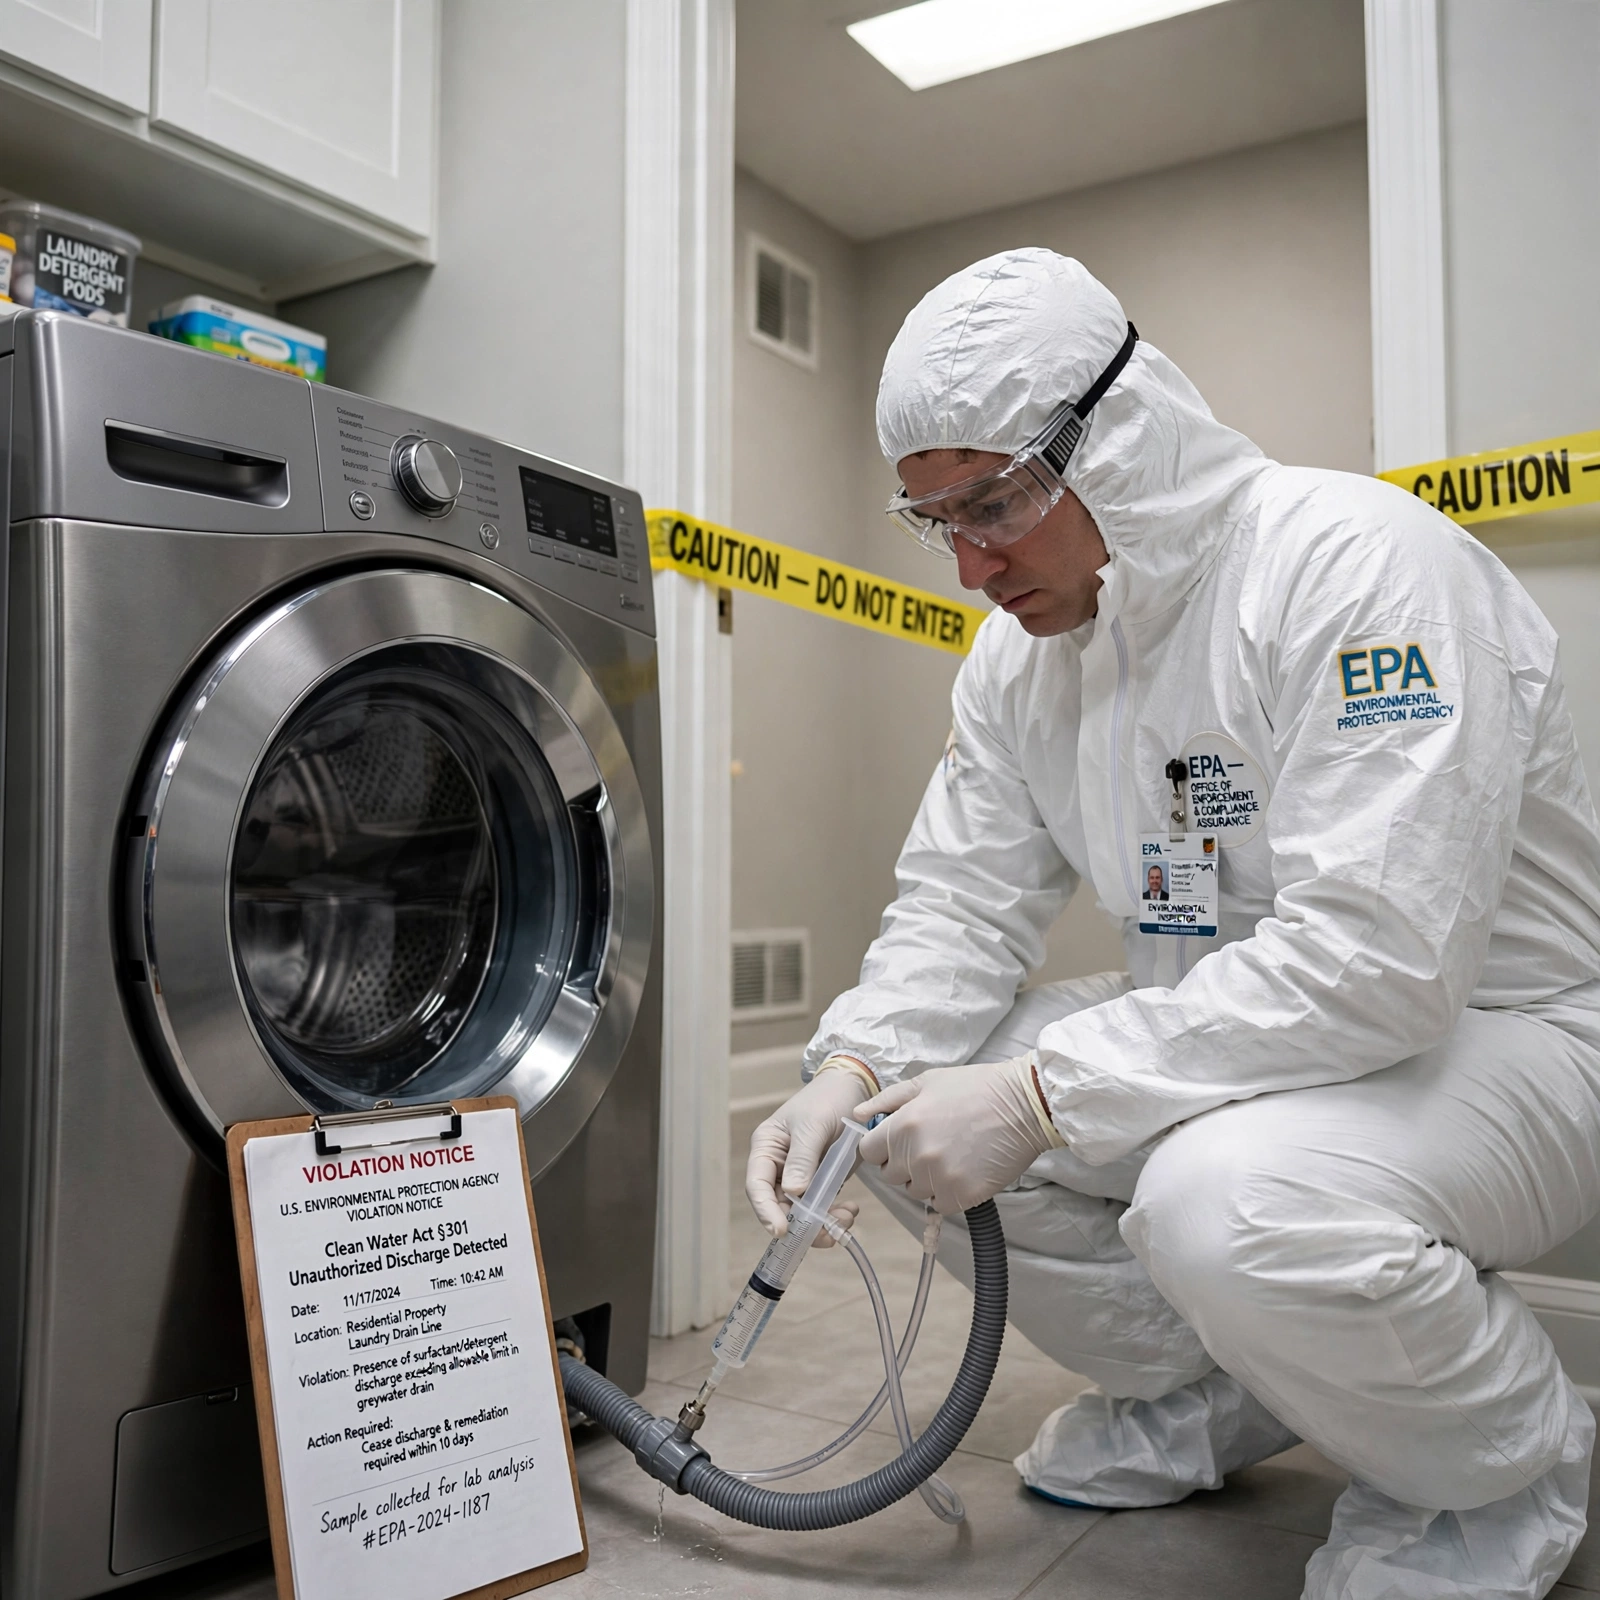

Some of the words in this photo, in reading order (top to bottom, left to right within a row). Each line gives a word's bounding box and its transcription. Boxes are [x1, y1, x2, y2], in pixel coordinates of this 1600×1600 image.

[47, 234, 119, 273] LAUNDRY
[39, 253, 124, 295] DETERGENT
[63, 278, 105, 307] PODS
[1412, 448, 1571, 514] CAUTION
[669, 520, 780, 590] CAUTION
[815, 567, 847, 610] DO
[853, 579, 896, 625] NOT
[901, 596, 966, 647] ENTER
[1338, 643, 1438, 699] EPA
[1337, 709, 1406, 731] PROTECTION
[1410, 705, 1454, 720] AGENCY
[1345, 692, 1441, 714] ENVIRONMENTAL
[1189, 755, 1226, 778] EPA
[1191, 781, 1219, 793] OFFICE
[1220, 780, 1232, 792] OF
[1197, 815, 1251, 828] ASSURANCE
[1142, 843, 1162, 855] EPA
[302, 1154, 404, 1184] VIOLATION
[410, 1145, 475, 1171] NOTICE
[280, 1202, 302, 1217] U.S.
[304, 1188, 396, 1213] ENVIRONMENTAL
[397, 1179, 459, 1200] PROTECTION
[462, 1172, 500, 1189] AGENCY
[347, 1203, 404, 1223] VIOLATION
[406, 1196, 443, 1214] NOTICE
[325, 1239, 364, 1258] Clean
[366, 1233, 408, 1251] Water
[412, 1227, 435, 1244] Act
[437, 1220, 469, 1242] §301
[289, 1254, 383, 1286] Unauthorized
[386, 1246, 450, 1270] Discharge
[453, 1233, 508, 1258] Detected
[291, 1303, 320, 1318] Date:
[343, 1286, 401, 1308] 11/17/2024
[429, 1276, 458, 1291] Time:
[459, 1270, 487, 1285] 10:42
[488, 1265, 504, 1279] AM
[294, 1325, 342, 1345] Location:
[346, 1309, 402, 1334] Residential
[404, 1303, 447, 1323] Property
[348, 1330, 391, 1350] Laundry
[393, 1323, 419, 1341] Drain
[421, 1321, 443, 1335] Line
[298, 1368, 350, 1388] Violation:
[352, 1357, 398, 1377] Presence
[400, 1350, 411, 1365] of
[413, 1330, 509, 1363] surfactant/detergent
[354, 1372, 403, 1393] discharge
[449, 1350, 489, 1371] allowable
[490, 1348, 510, 1361] limit
[511, 1345, 520, 1355] in
[356, 1389, 408, 1413] greywater
[410, 1381, 435, 1397] drain
[307, 1433, 343, 1451] Action
[344, 1418, 394, 1441] Required:
[361, 1438, 393, 1454] Cease
[395, 1425, 442, 1447] discharge
[443, 1418, 453, 1433] &
[454, 1405, 509, 1429] remediation
[363, 1448, 407, 1472] required
[408, 1440, 438, 1459] within
[439, 1436, 451, 1450] 10
[452, 1431, 475, 1449] days
[320, 1503, 369, 1534] Sample
[375, 1481, 430, 1516] collected
[437, 1475, 459, 1496] for
[463, 1467, 483, 1489] lab
[488, 1455, 535, 1483] analysis
[362, 1493, 491, 1550] #EPA-2024-1187
